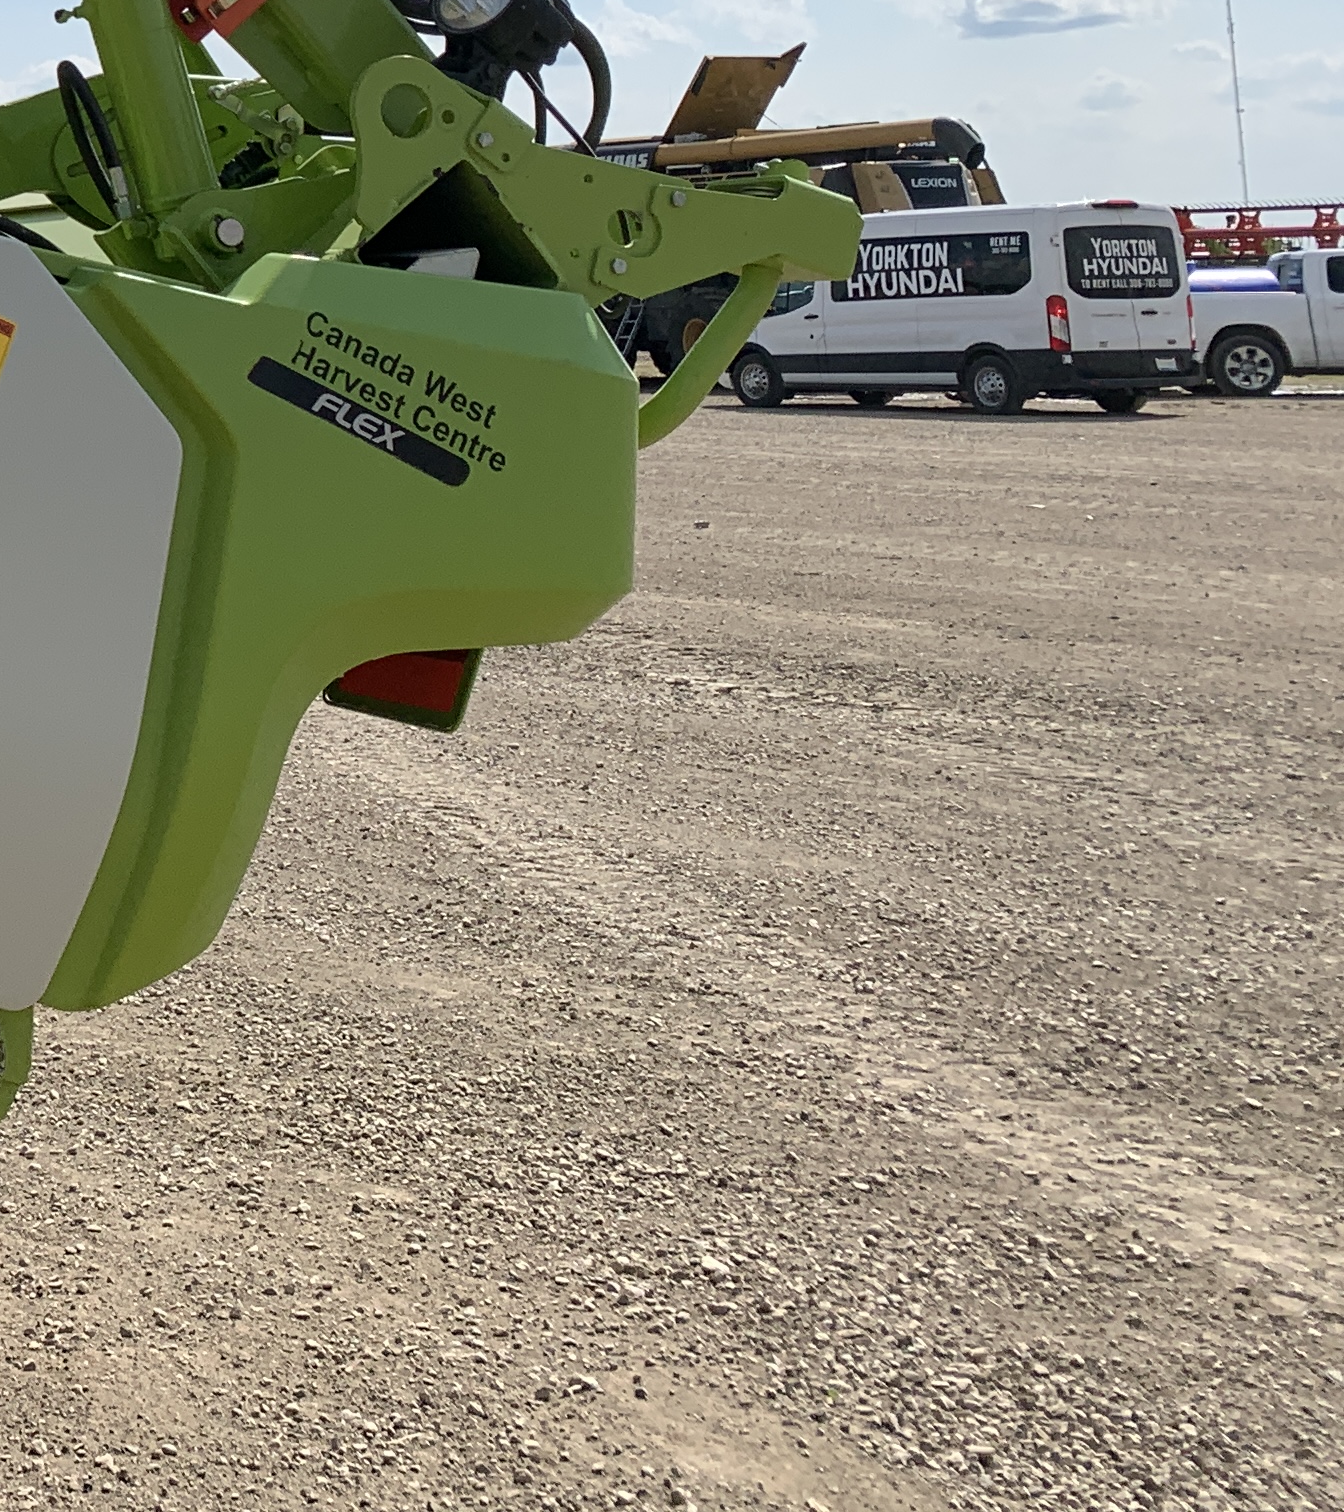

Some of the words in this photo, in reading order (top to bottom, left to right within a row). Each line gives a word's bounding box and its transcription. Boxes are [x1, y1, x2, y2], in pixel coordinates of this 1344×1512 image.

[910, 178, 958, 188] LEXION
[859, 241, 949, 271] YORKTON
[1090, 237, 1158, 257] YORKTON
[1083, 257, 1169, 276] HYUNDAI
[847, 268, 965, 298] HYUNDAI
[1081, 279, 1091, 288] TO
[1093, 279, 1110, 288] RENT
[1112, 279, 1127, 288] CALL
[307, 312, 415, 386] Canada
[426, 370, 497, 429] West
[291, 340, 407, 419] Harvest
[412, 406, 506, 472] Centre
[312, 393, 405, 451] FLEX
